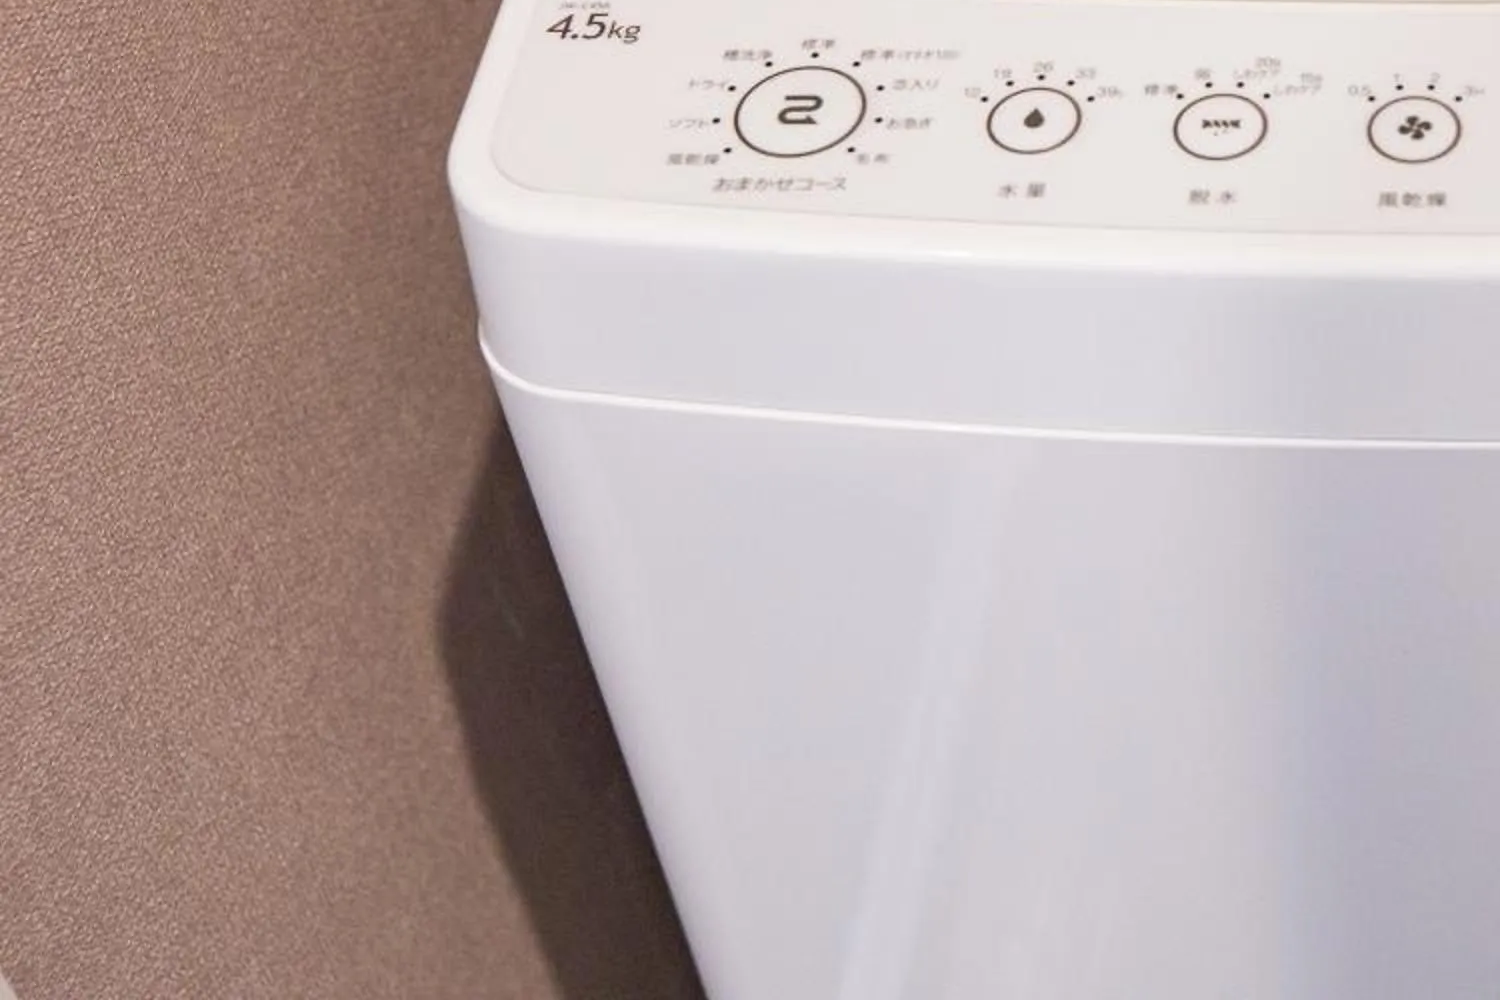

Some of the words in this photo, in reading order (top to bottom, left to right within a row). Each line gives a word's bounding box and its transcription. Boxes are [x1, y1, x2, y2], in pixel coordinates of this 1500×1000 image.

[546, 13, 641, 44] 4.5kg
[713, 177, 847, 192] おまかせコース
